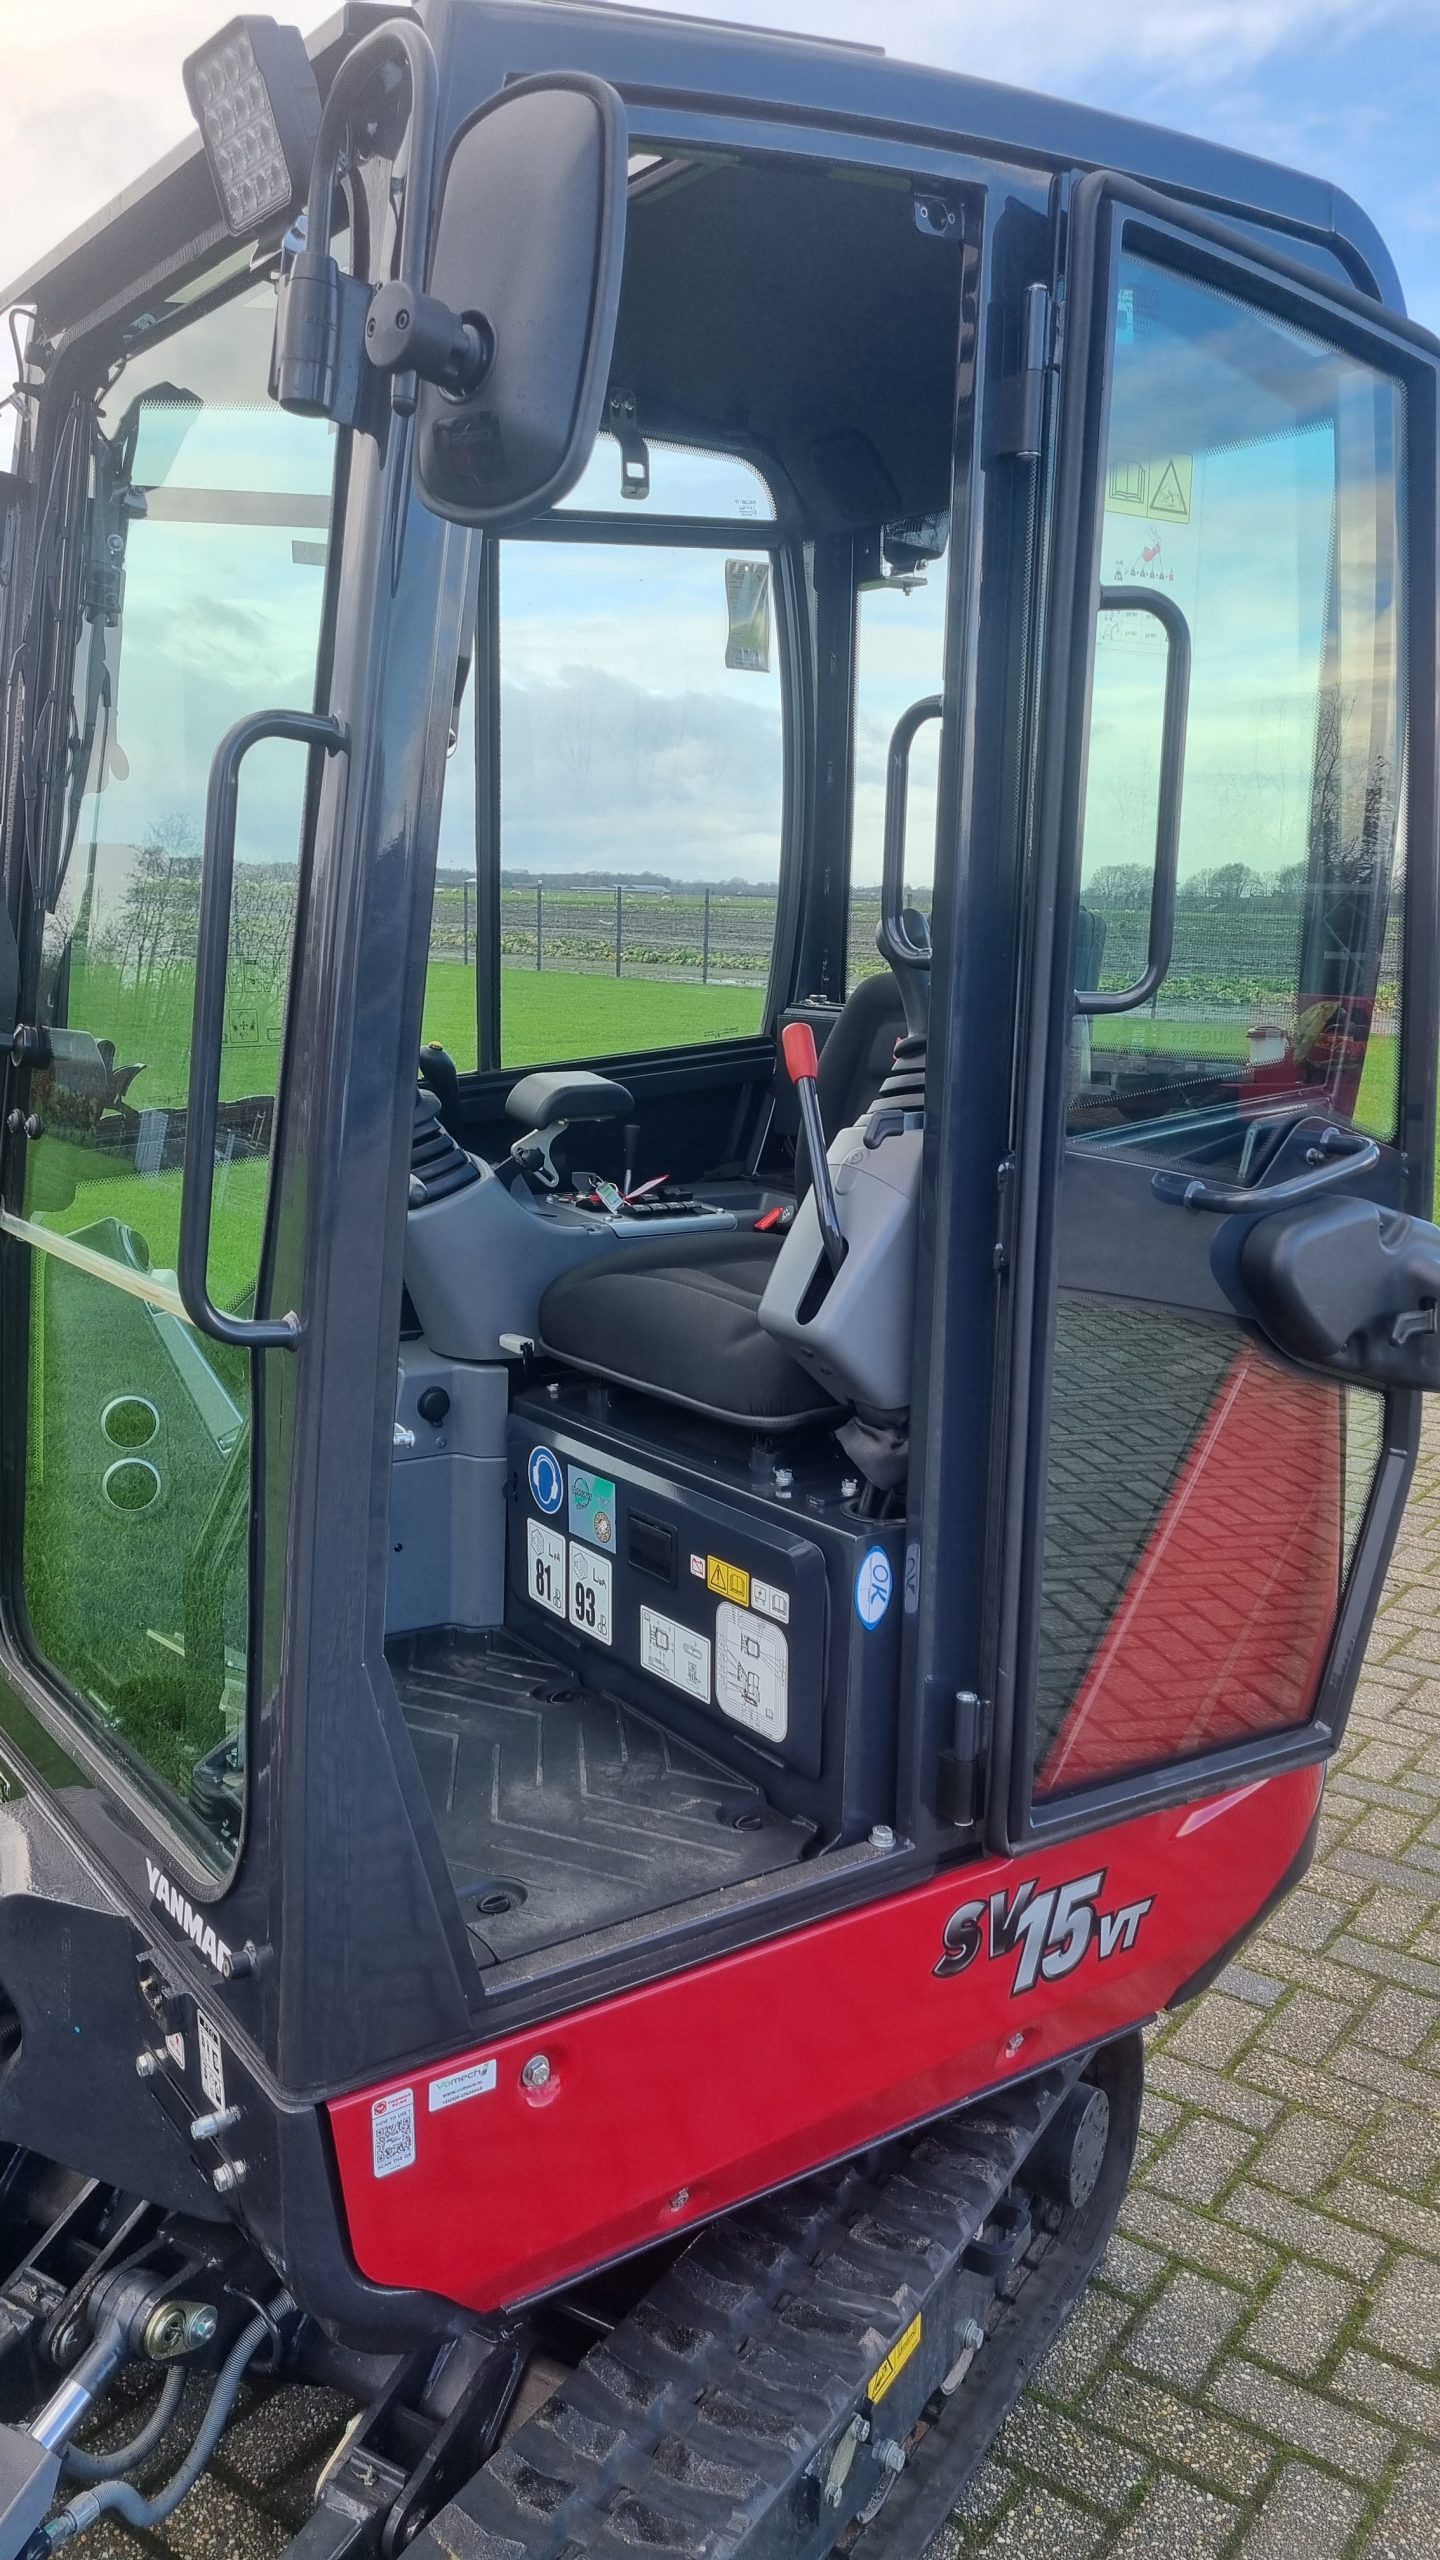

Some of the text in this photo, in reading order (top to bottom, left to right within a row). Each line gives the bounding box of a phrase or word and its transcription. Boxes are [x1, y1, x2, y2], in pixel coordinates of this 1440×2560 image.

[536, 1558, 552, 1601] 81
[870, 1564, 889, 1605] OK
[575, 1581, 596, 1627] 93
[1097, 1895, 1157, 1962] VT
[436, 2067, 481, 2090] Vomech
[378, 2160, 392, 2170] SCAN
